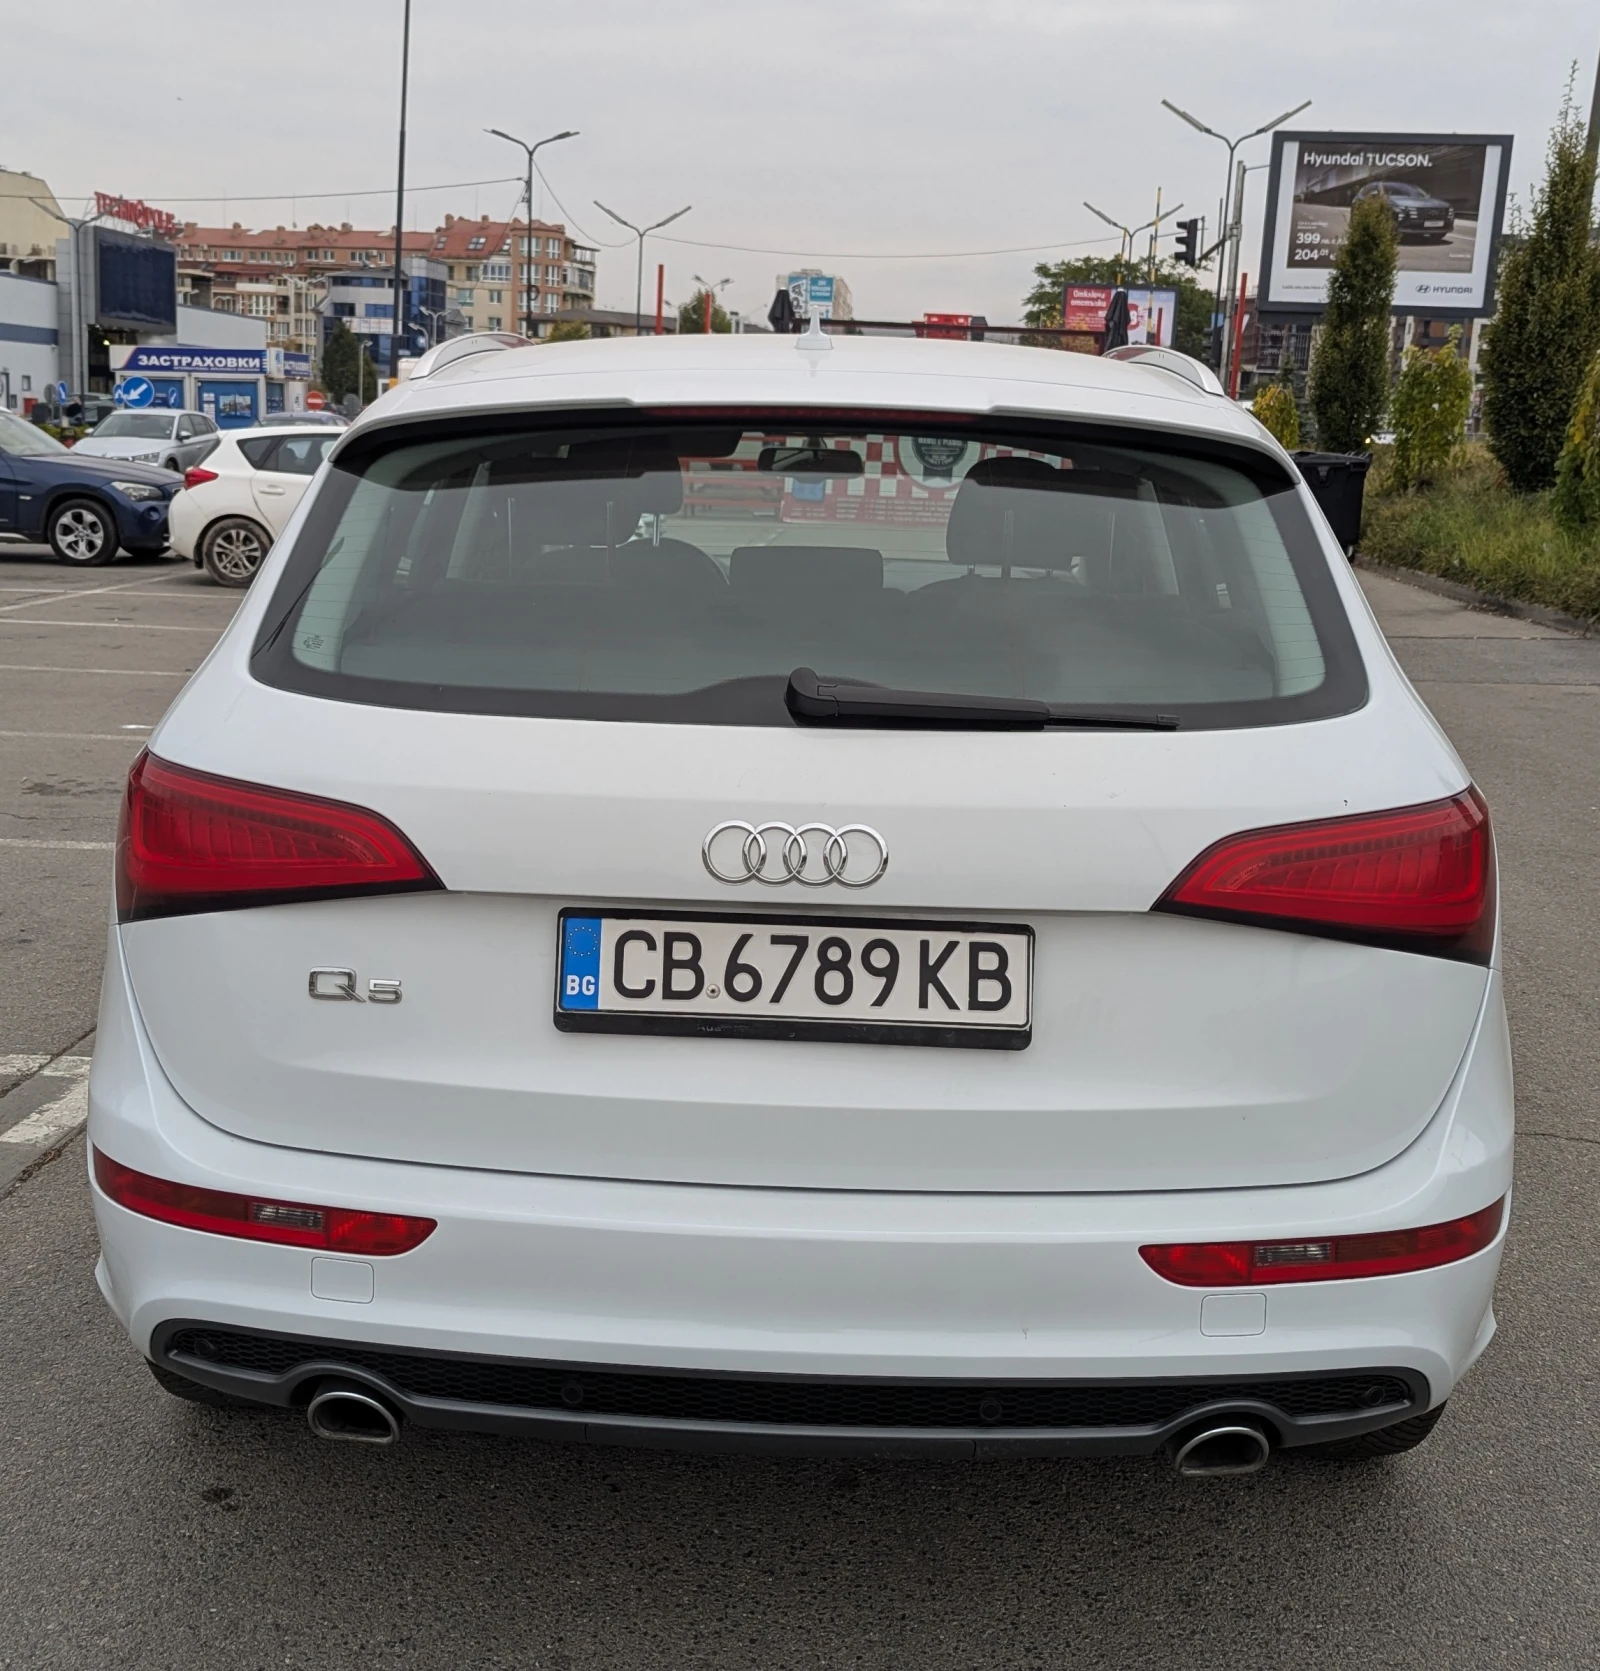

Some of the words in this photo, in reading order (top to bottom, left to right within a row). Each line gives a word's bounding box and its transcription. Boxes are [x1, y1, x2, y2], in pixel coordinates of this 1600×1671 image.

[1303, 152, 1363, 167] Hyundai
[1366, 153, 1433, 167] TUCSON.
[1295, 232, 1320, 244] 399
[1433, 286, 1473, 294] HYUNDAI
[138, 355, 260, 369] ЗАСТРАХОВКИ
[613, 929, 705, 1000] CB
[723, 933, 900, 1007] 6789
[917, 938, 1012, 1012] KB
[308, 966, 403, 1004] Q5
[566, 975, 595, 996] BG
